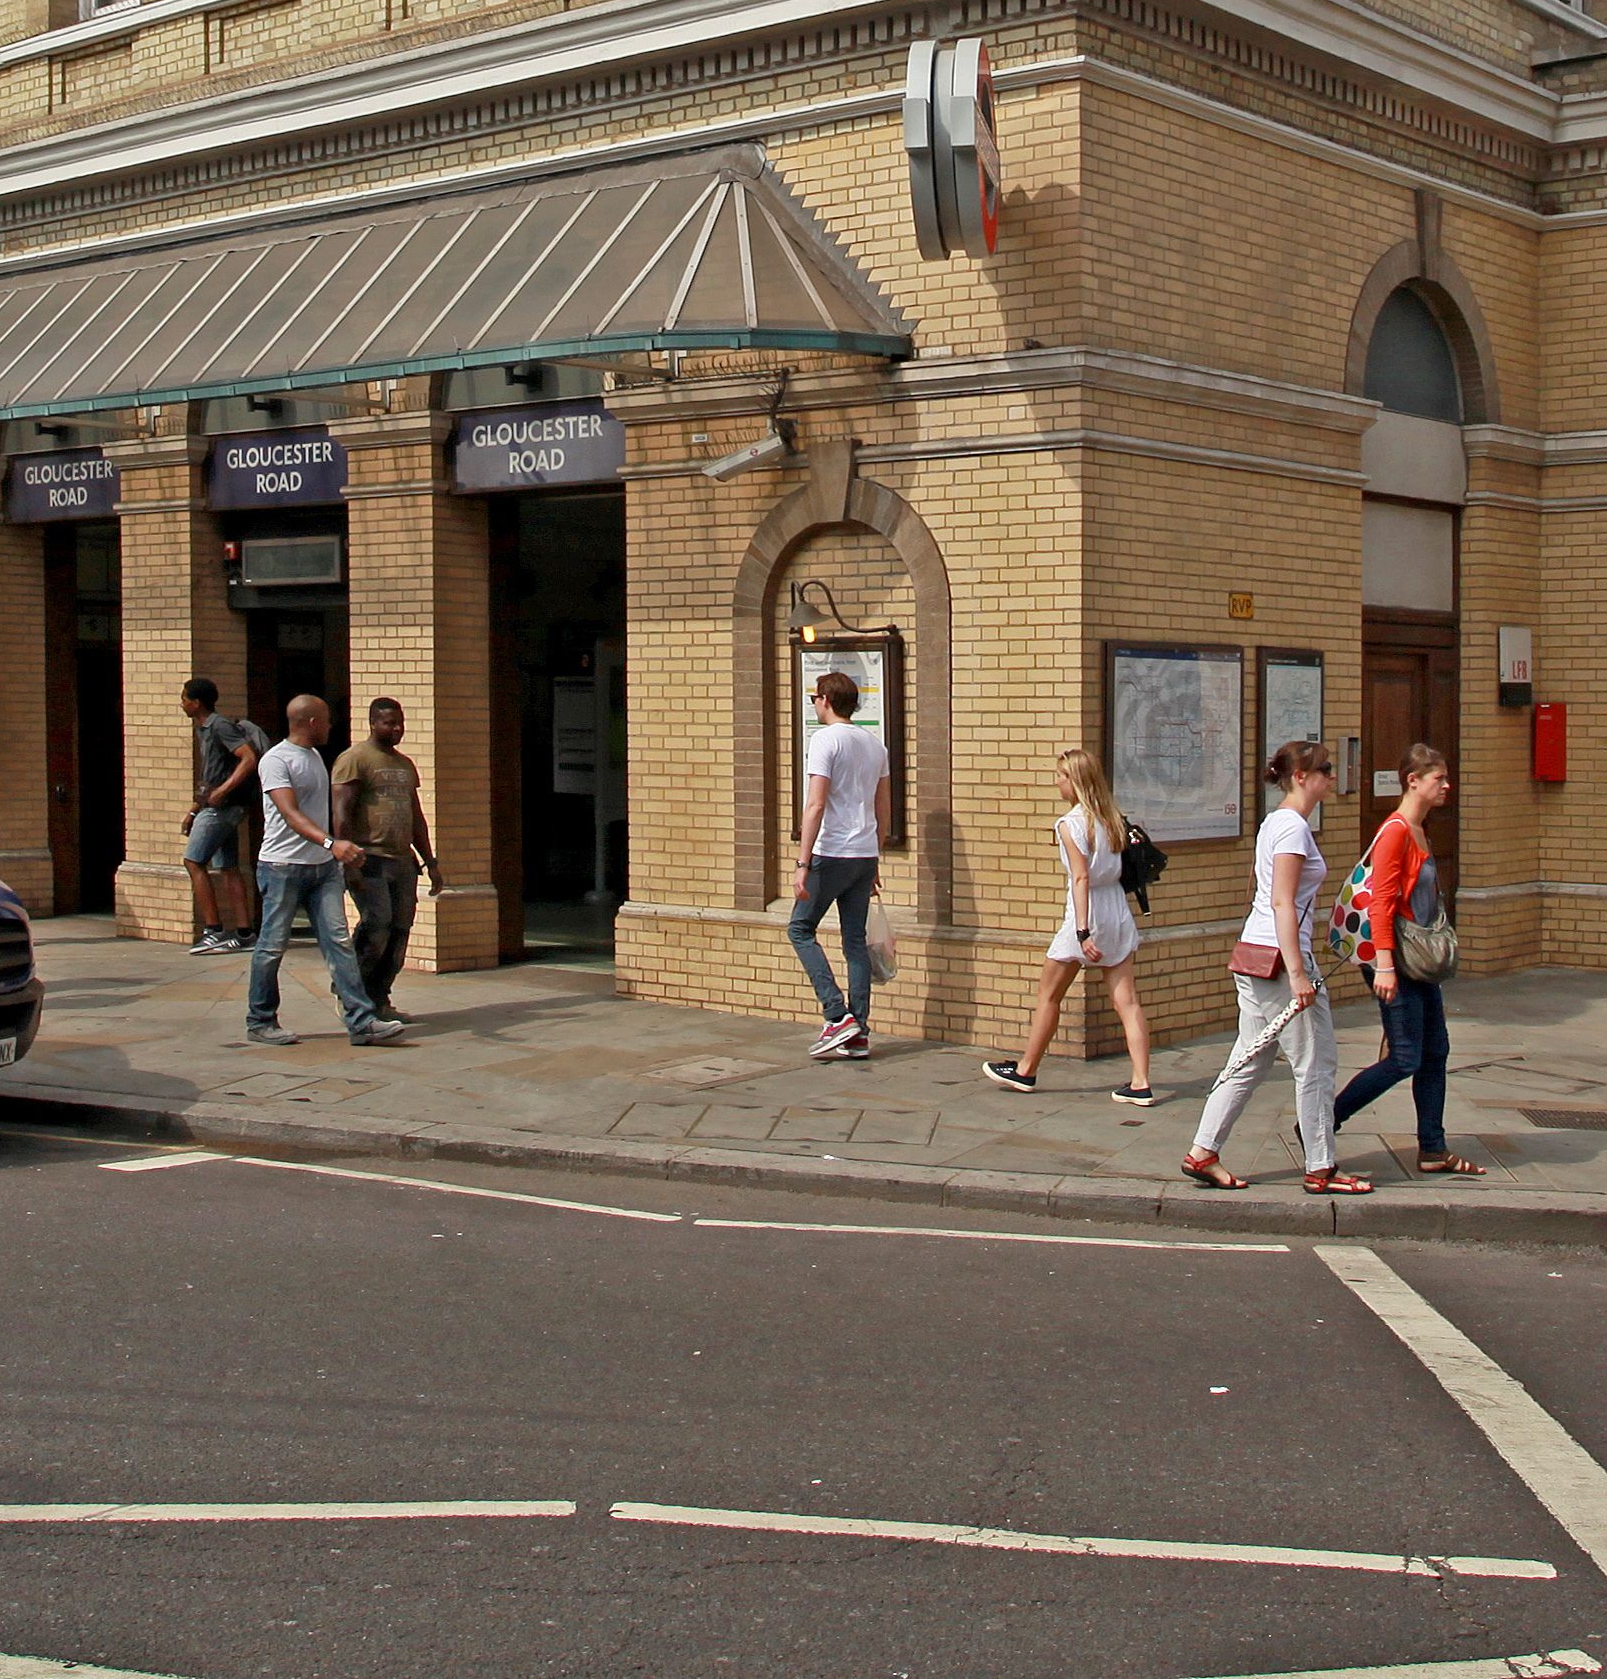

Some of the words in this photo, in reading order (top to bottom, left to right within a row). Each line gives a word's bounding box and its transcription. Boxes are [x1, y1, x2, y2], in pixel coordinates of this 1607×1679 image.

[472, 414, 604, 448] GLOUCESTER
[226, 441, 334, 470] GLOUCESTER
[508, 448, 566, 475] ROAD
[24, 458, 114, 486] GLOUCESTER
[256, 471, 303, 495] ROAD
[49, 485, 89, 508] ROAD
[1231, 598, 1253, 614] RVP
[1512, 660, 1528, 680] LFB
